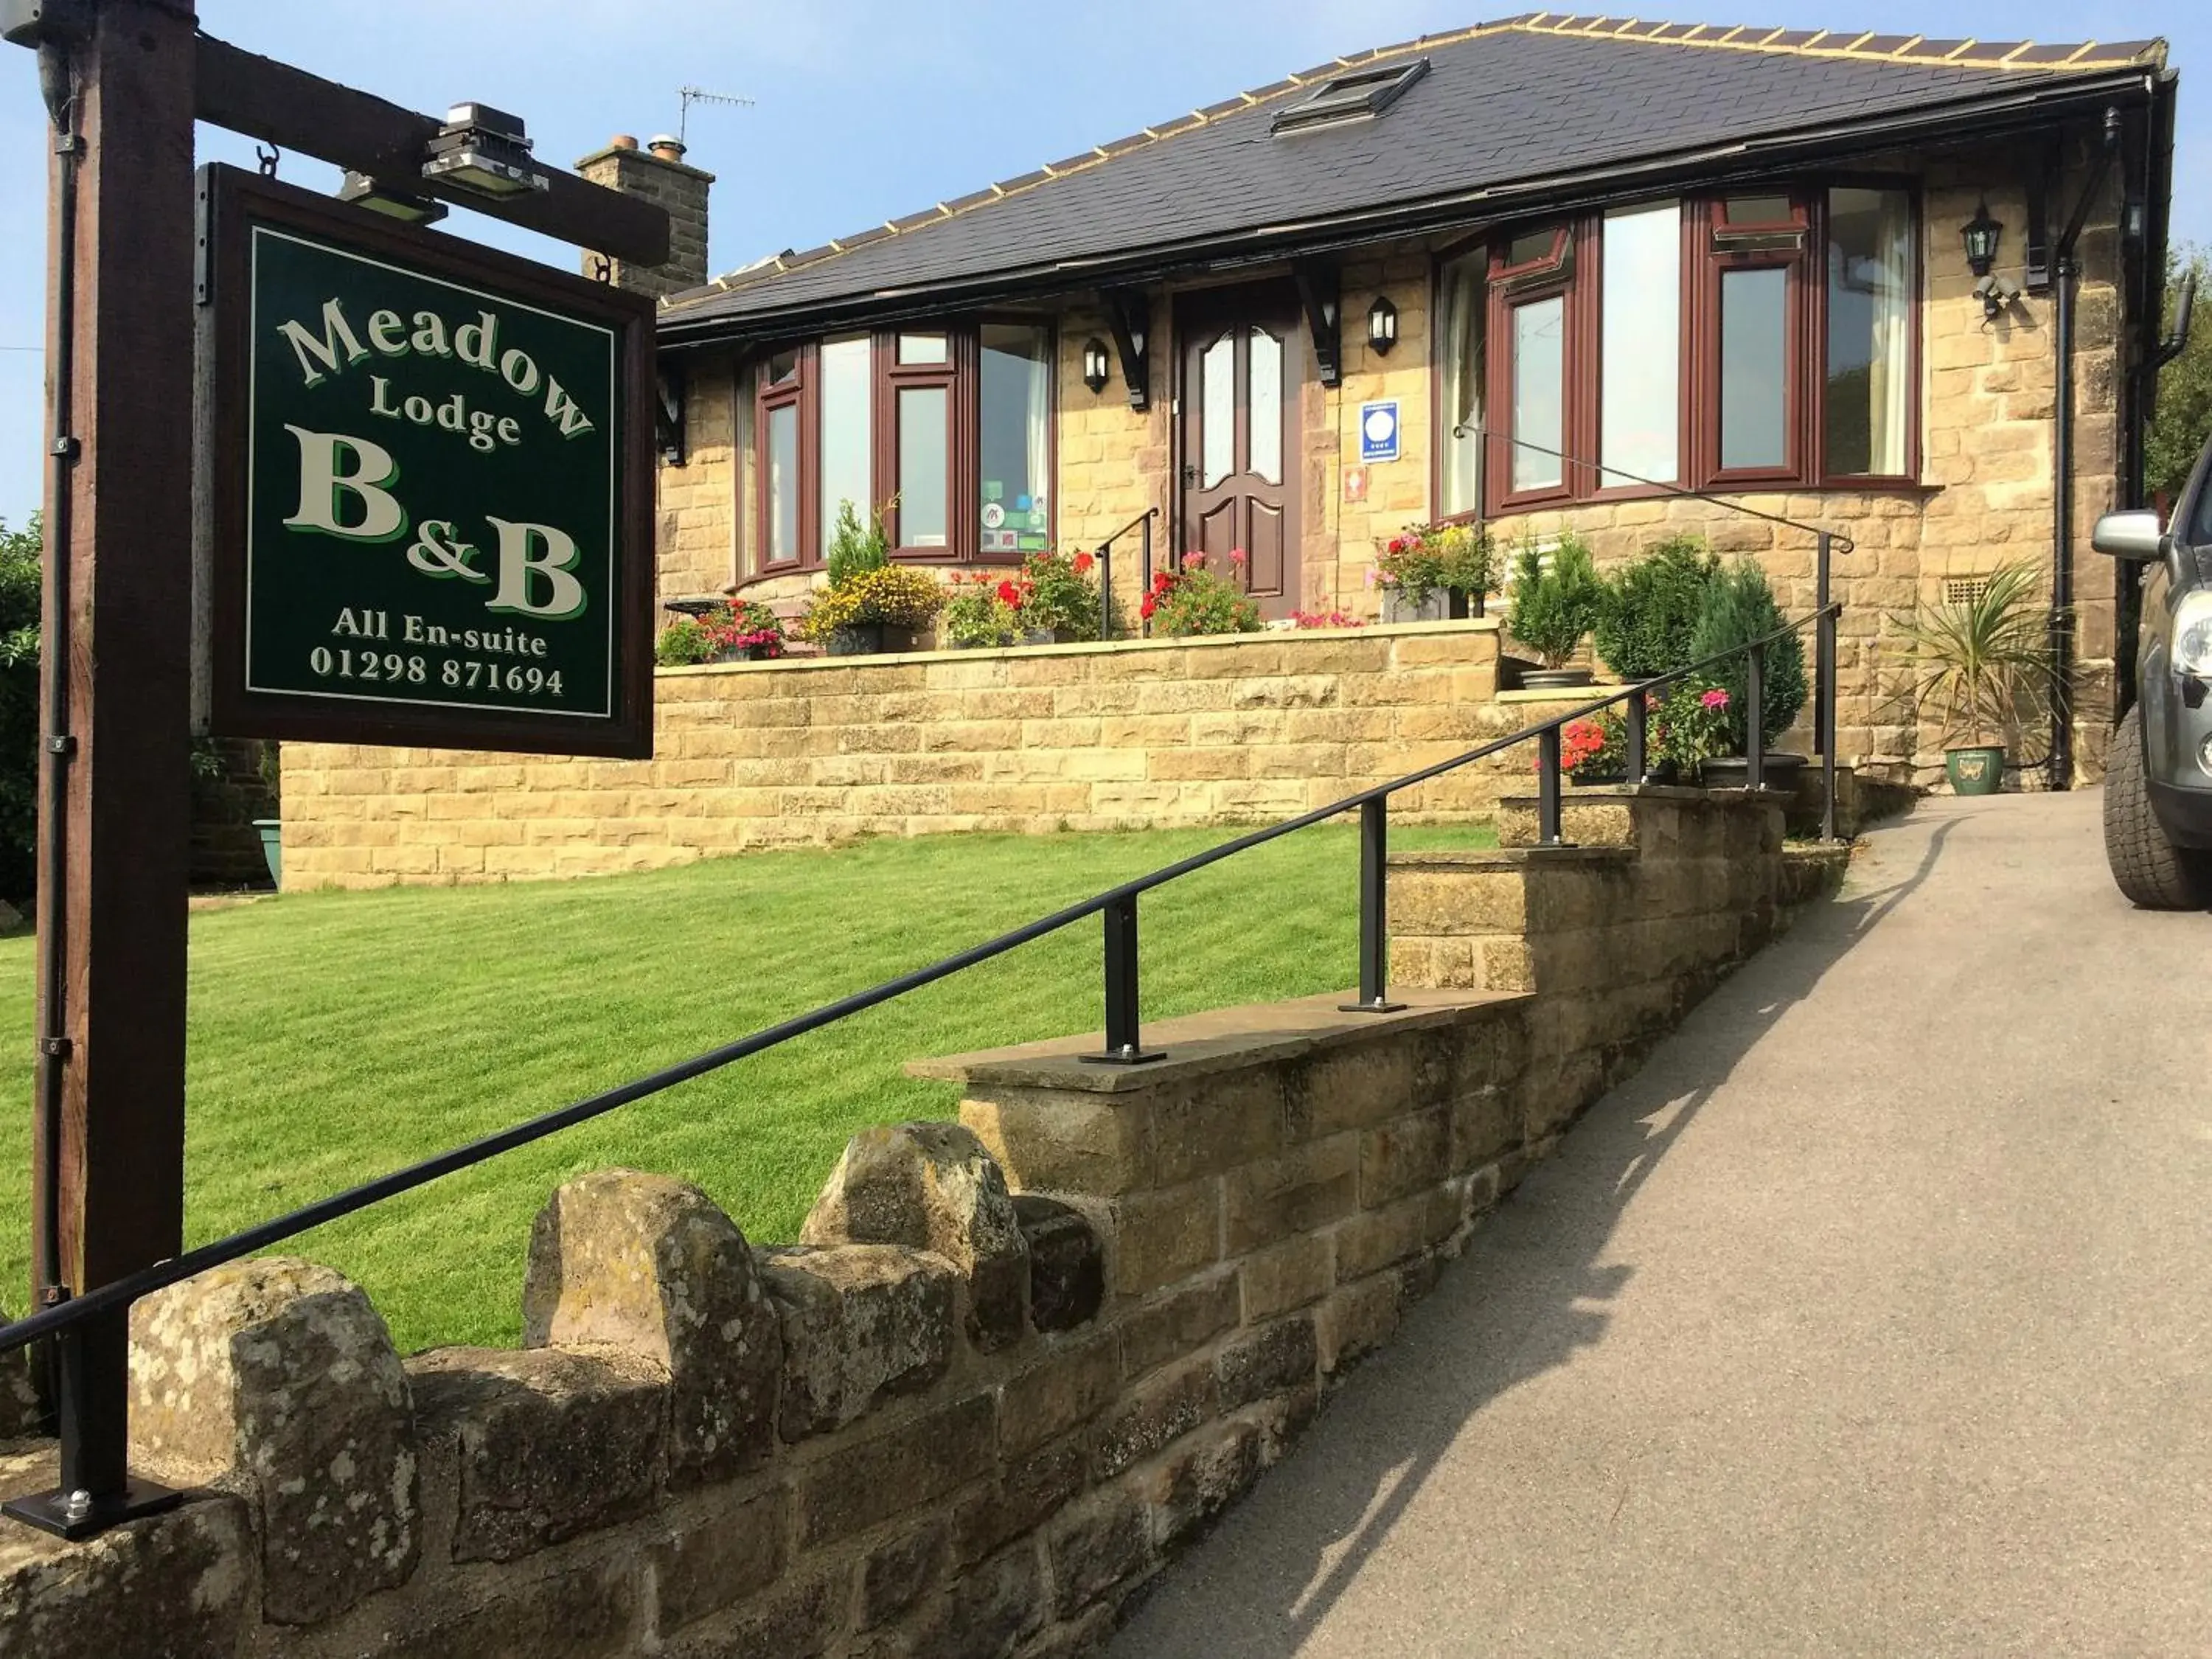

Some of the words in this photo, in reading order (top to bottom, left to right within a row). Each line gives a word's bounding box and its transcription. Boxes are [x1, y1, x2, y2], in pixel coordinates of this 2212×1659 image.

[277, 296, 595, 440] Meadow
[369, 375, 522, 452] Lodge
[331, 607, 387, 641] All
[403, 615, 548, 657] En-suite
[310, 646, 427, 684] 01298
[442, 656, 564, 696] 871694
